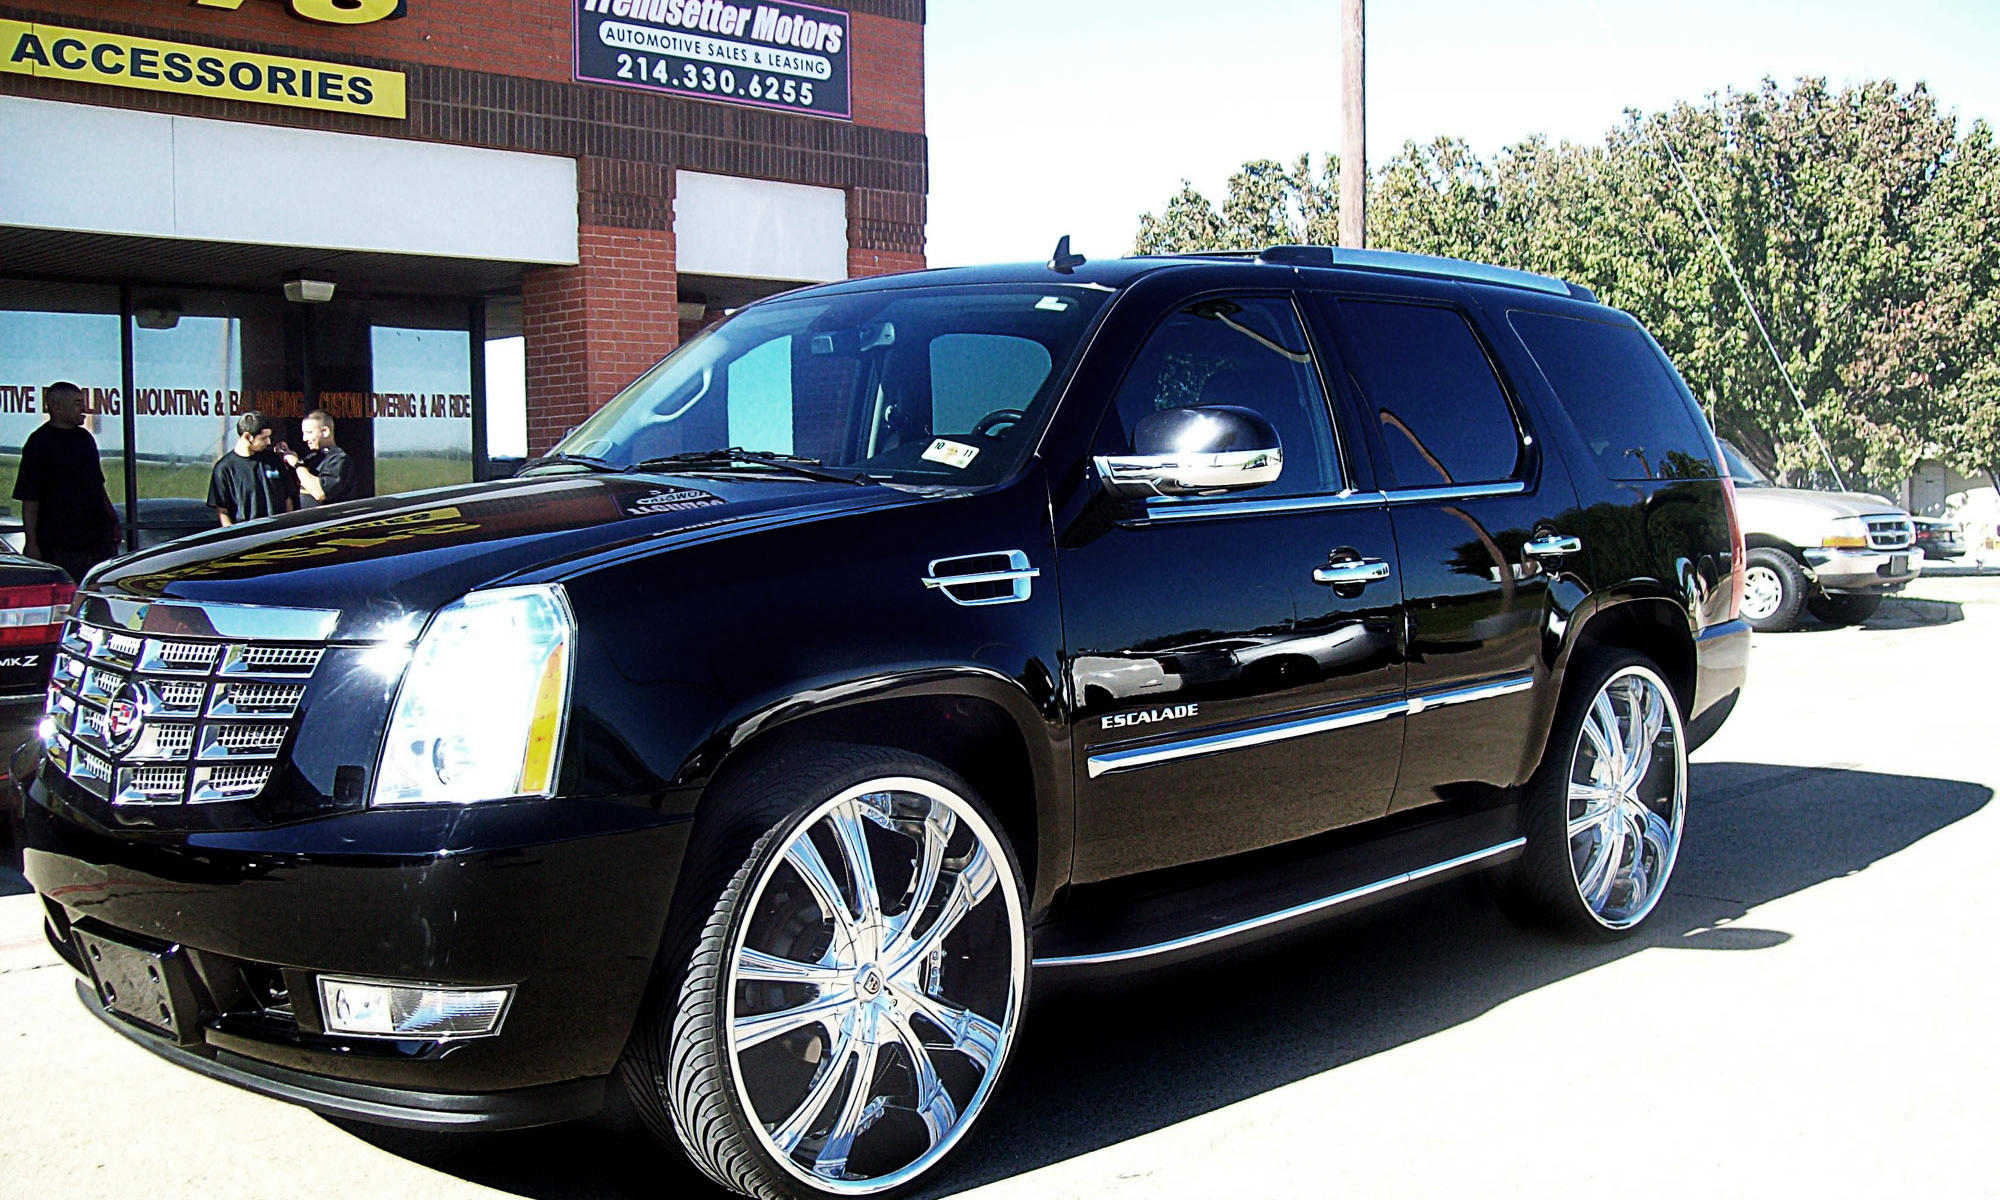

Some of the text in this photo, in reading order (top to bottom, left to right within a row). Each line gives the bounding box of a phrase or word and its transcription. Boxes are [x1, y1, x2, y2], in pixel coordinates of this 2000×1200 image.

[751, 5, 843, 54] Motors
[11, 33, 374, 105] ACCESSORIES
[606, 27, 825, 74] AUTOMOTIVE SALES & LEASING
[617, 53, 813, 106] 214.330.6255
[0, 386, 35, 413] TIVE
[136, 388, 209, 416] MOUNTING
[215, 390, 224, 416] &
[365, 392, 416, 418] LOWERING
[420, 394, 427, 417] &
[430, 394, 446, 417] AIR
[449, 394, 470, 417] RIDE
[1101, 703, 1199, 730] ESCALADE
